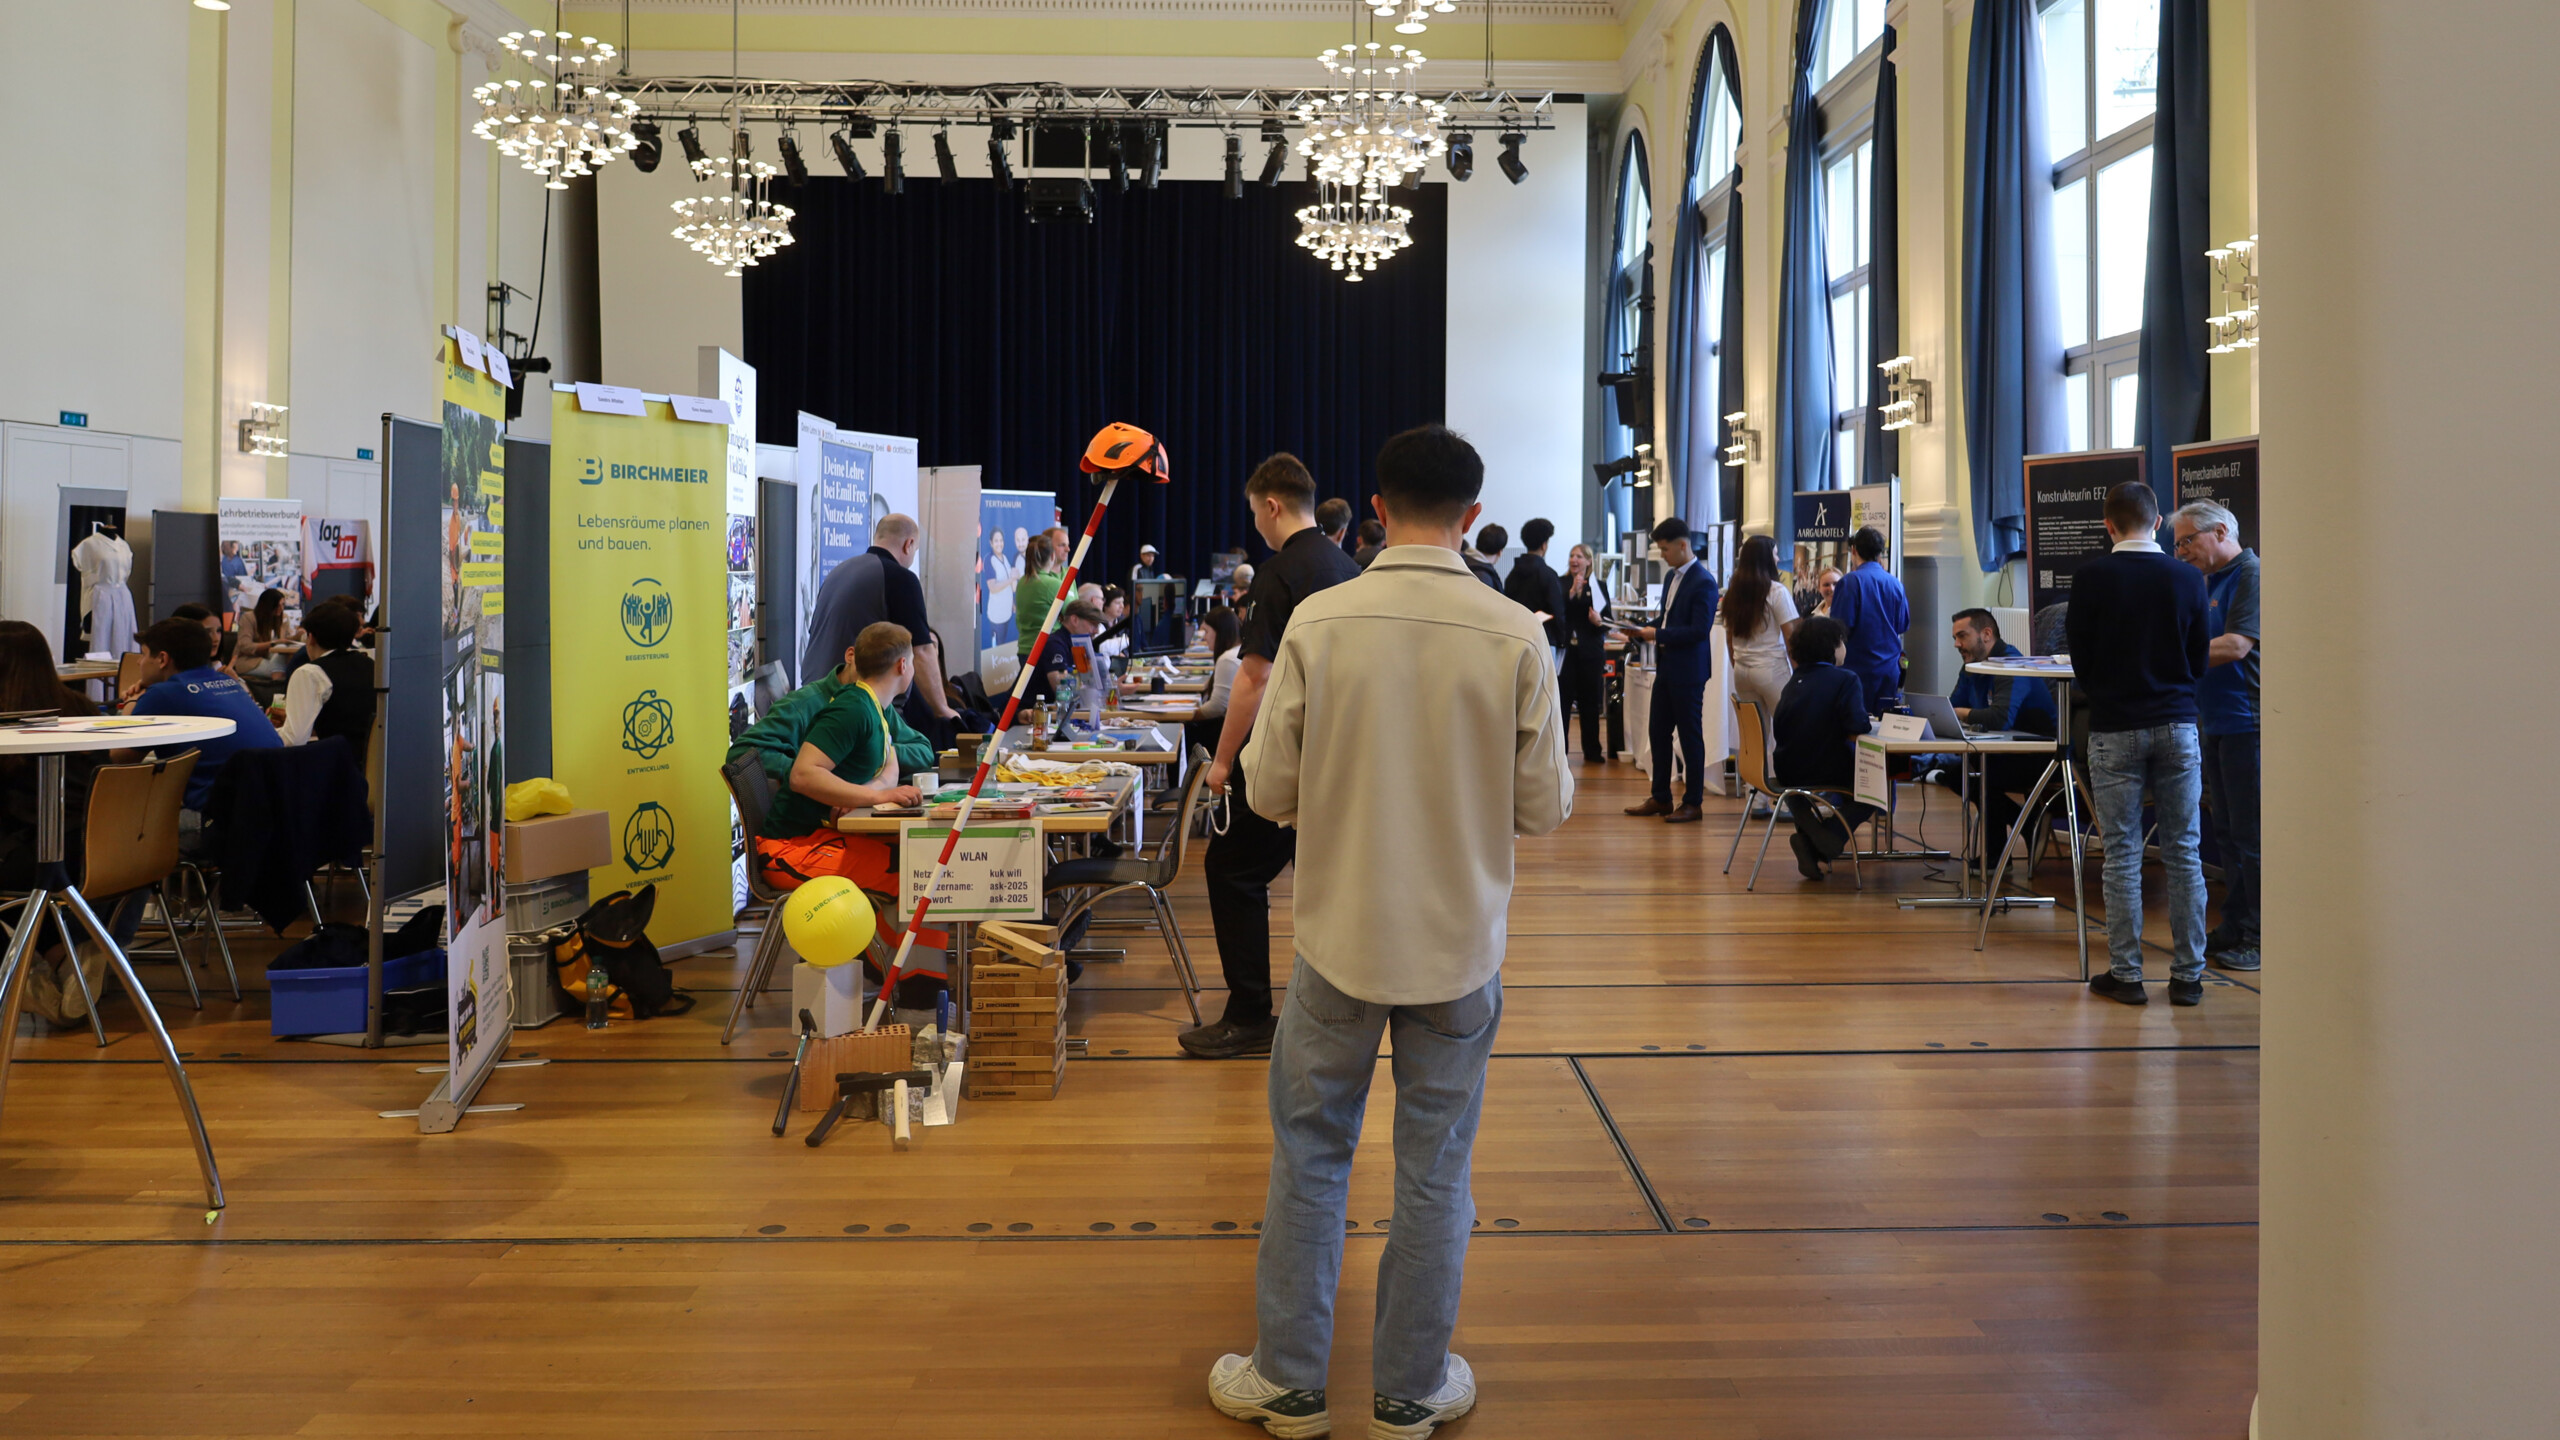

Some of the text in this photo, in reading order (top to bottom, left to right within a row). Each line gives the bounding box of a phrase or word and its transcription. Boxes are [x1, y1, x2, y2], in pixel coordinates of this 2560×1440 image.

[611, 463, 709, 484] BIRCHMEIER
[823, 455, 865, 481] Deine Lehre
[823, 479, 835, 500] bei
[836, 481, 852, 502] Emil
[2037, 486, 2107, 504] Konstrukteur/in EFZ
[2181, 483, 2215, 499] Produktions-
[985, 500, 1022, 509] TERTIANUM
[1854, 502, 1871, 511] BERUFE
[219, 509, 300, 520] Lehrbetriebsverbund
[823, 503, 863, 526] Nutze deine
[1854, 511, 1887, 521] HOTEL GASTRO
[578, 514, 710, 533] Lebensräume planen
[319, 519, 341, 548] log
[823, 527, 852, 548] Talente.
[578, 536, 651, 551] und bauen.
[625, 653, 670, 661] BEGEISTERUNG
[627, 763, 670, 775] ENTWICKLUNG
[960, 851, 988, 862] WLAN
[913, 869, 954, 879] Netzrk:
[989, 868, 1022, 878] kuk wifi
[989, 881, 1028, 891] ask-2025
[813, 888, 850, 912] BIRCHMEIER
[913, 895, 953, 904] Pwort:
[989, 894, 1028, 904] ask-2025
